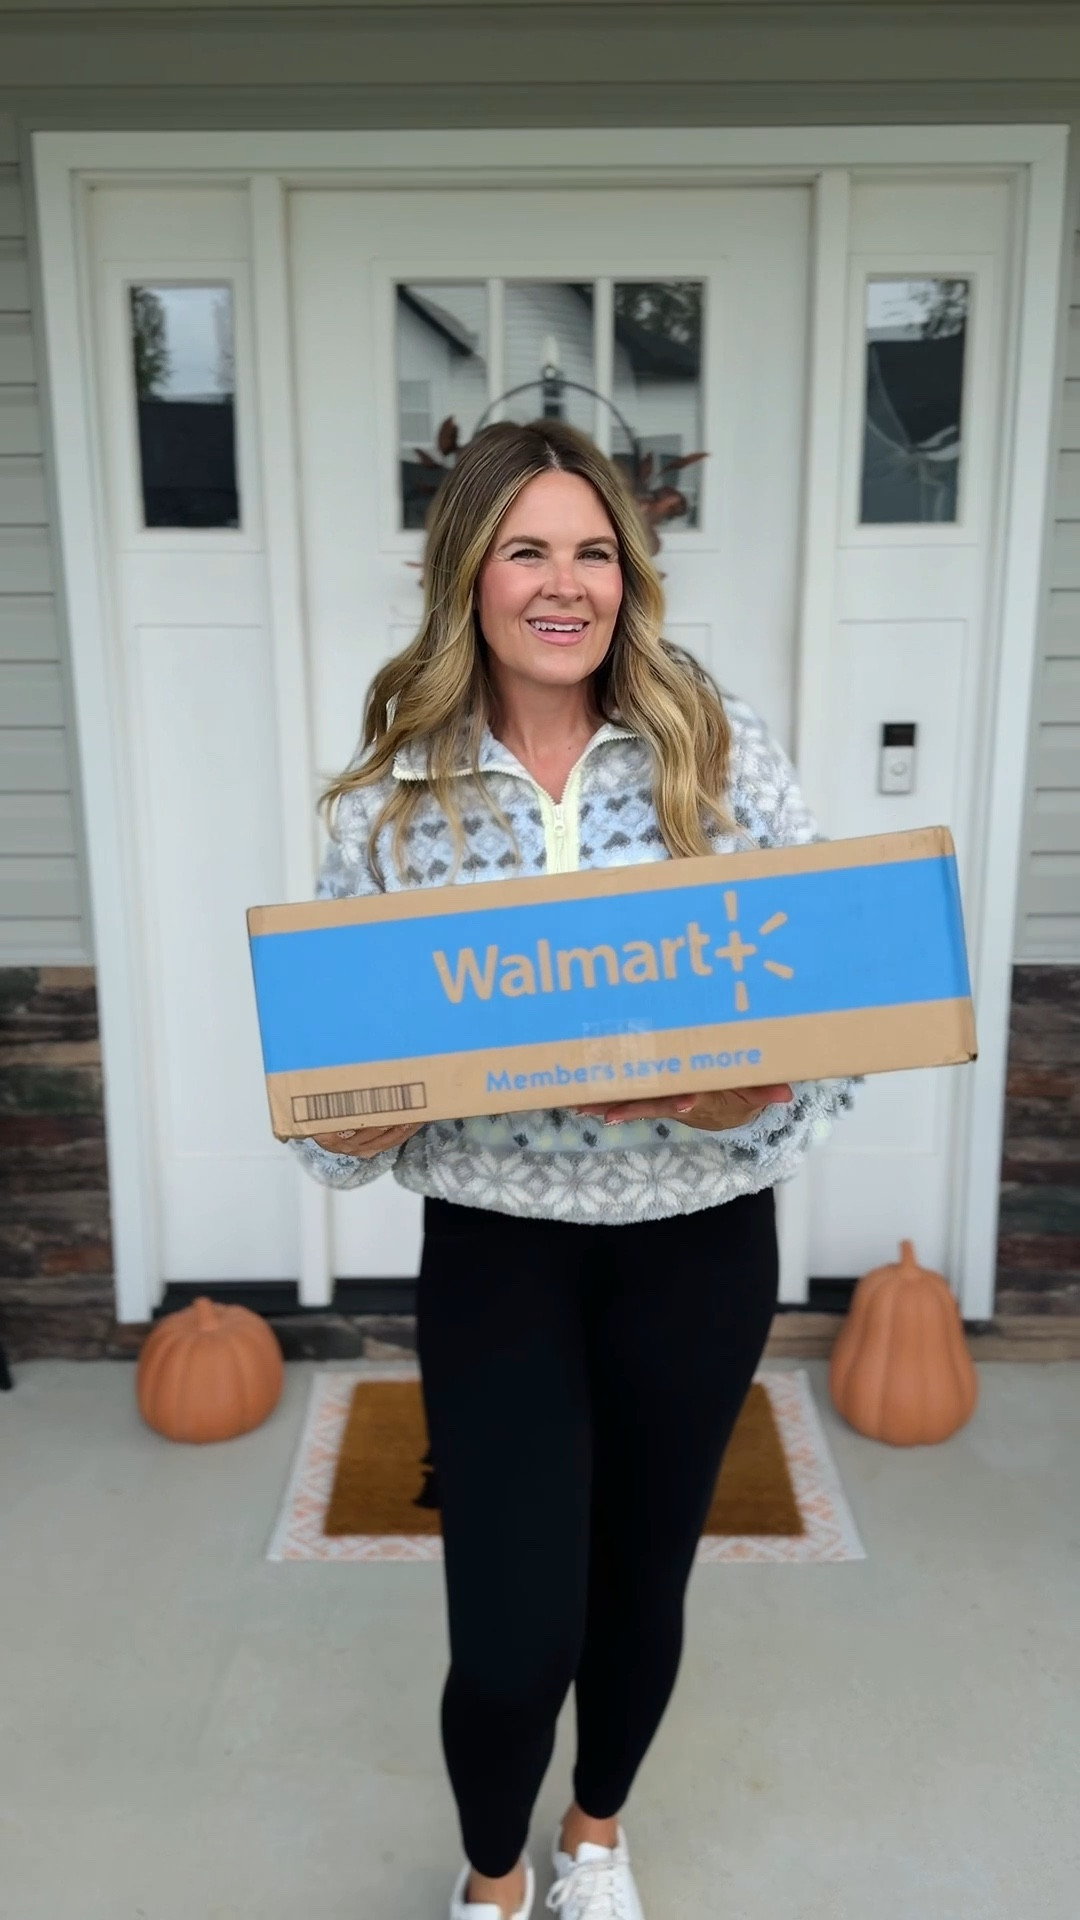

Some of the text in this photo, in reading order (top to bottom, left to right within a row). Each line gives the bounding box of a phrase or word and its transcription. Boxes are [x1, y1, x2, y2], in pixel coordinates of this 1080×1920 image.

[486, 1048, 761, 1093] Members save more
